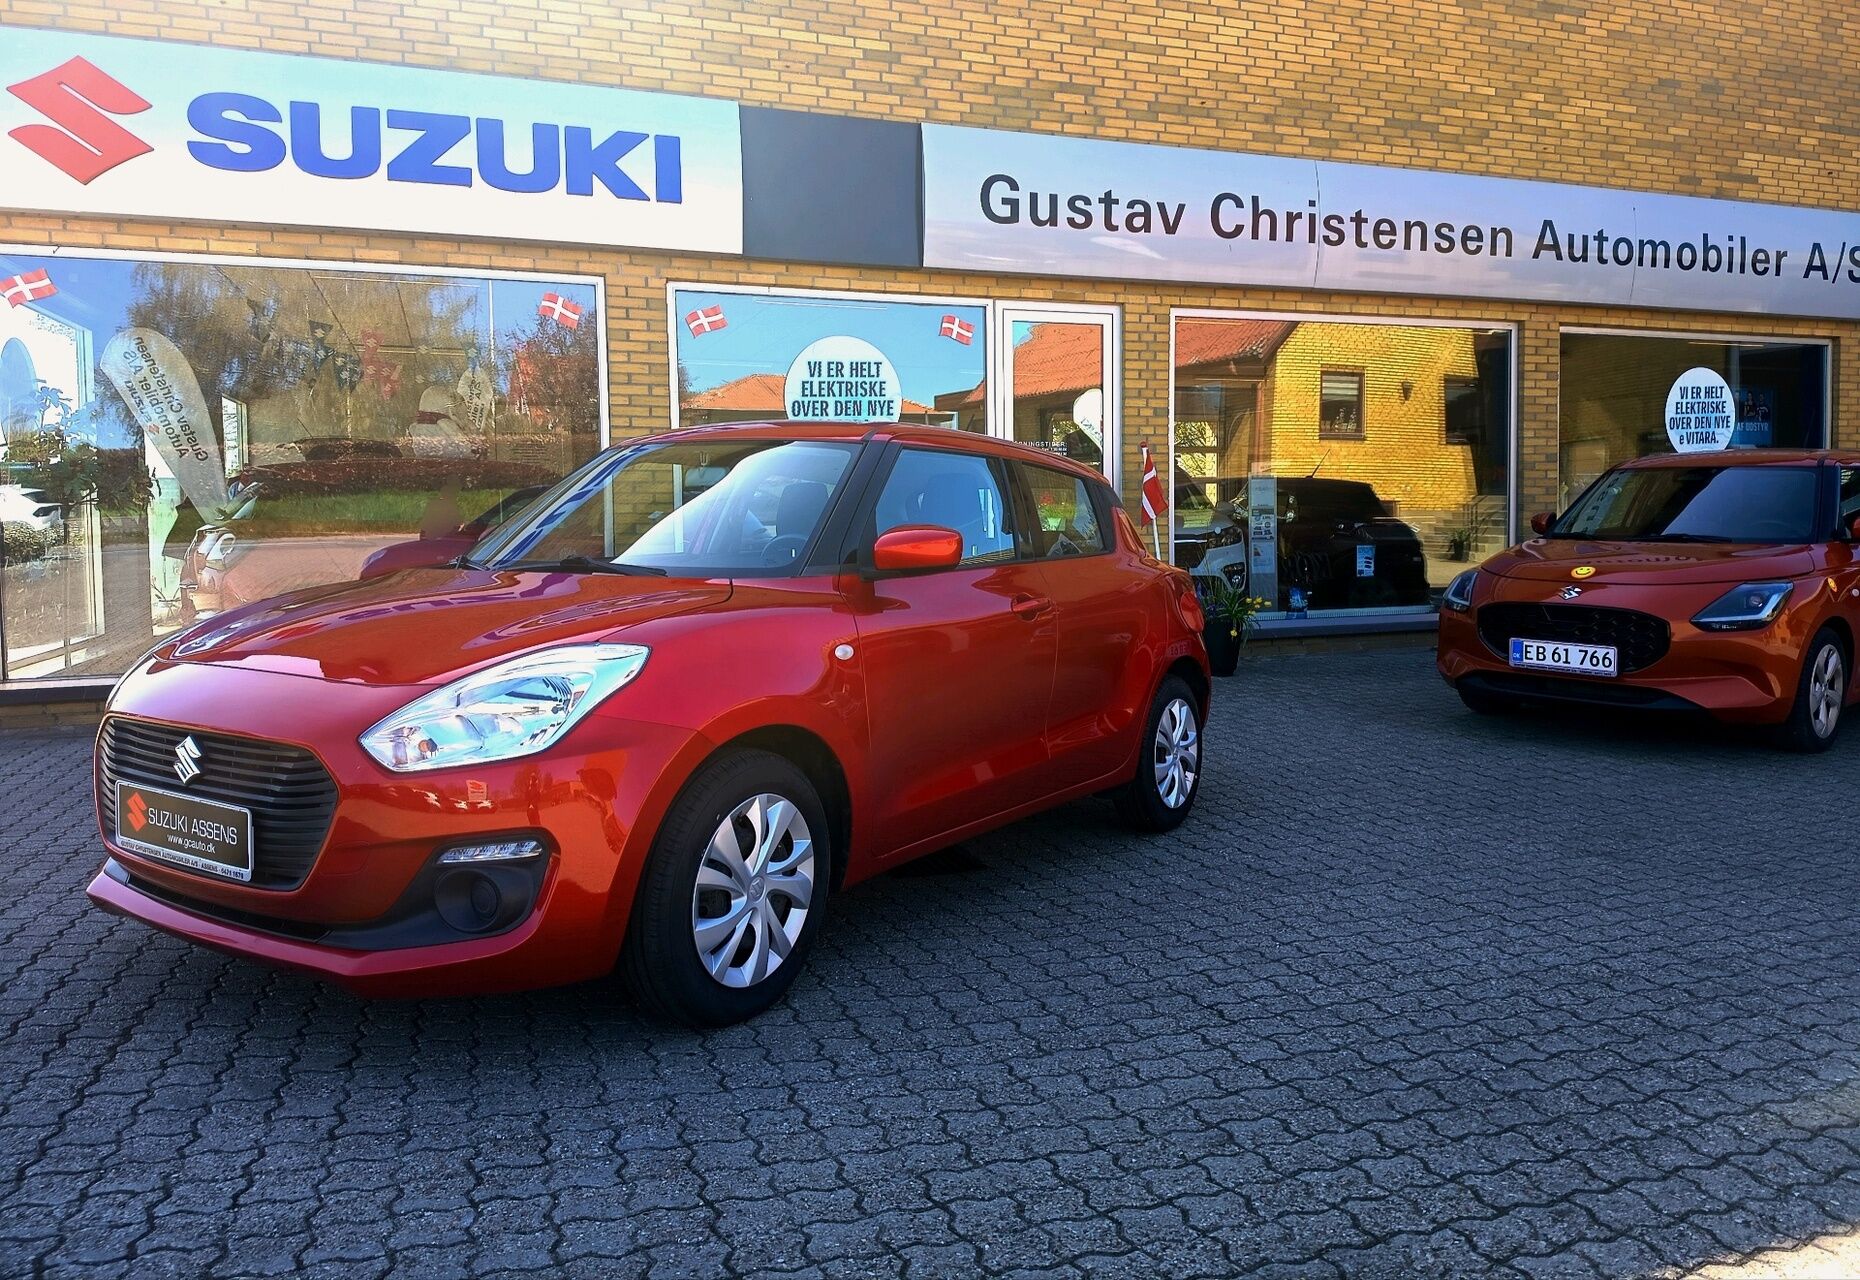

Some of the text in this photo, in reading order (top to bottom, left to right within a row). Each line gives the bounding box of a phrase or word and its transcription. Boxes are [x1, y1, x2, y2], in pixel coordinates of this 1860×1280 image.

[187, 92, 682, 204] SUZUKI
[979, 174, 1186, 235] Gustav
[1209, 191, 1514, 259] Christensen
[1532, 218, 1789, 279] Automobiler
[807, 361, 882, 378] VI ER HELT
[801, 381, 886, 397] ELEKTRISKE
[1680, 386, 1724, 399] VI ER HELT
[791, 400, 894, 417] OVER DEN NYE
[1675, 401, 1726, 414] ELEKTRISKE
[1669, 415, 1731, 430] OVER DEN NYE
[1679, 431, 1719, 445] e VITARA.
[1524, 644, 1613, 668] EB 61 766
[148, 807, 238, 845] SUZUKI ASSENS
[166, 834, 216, 854] www.gcauto.dk
